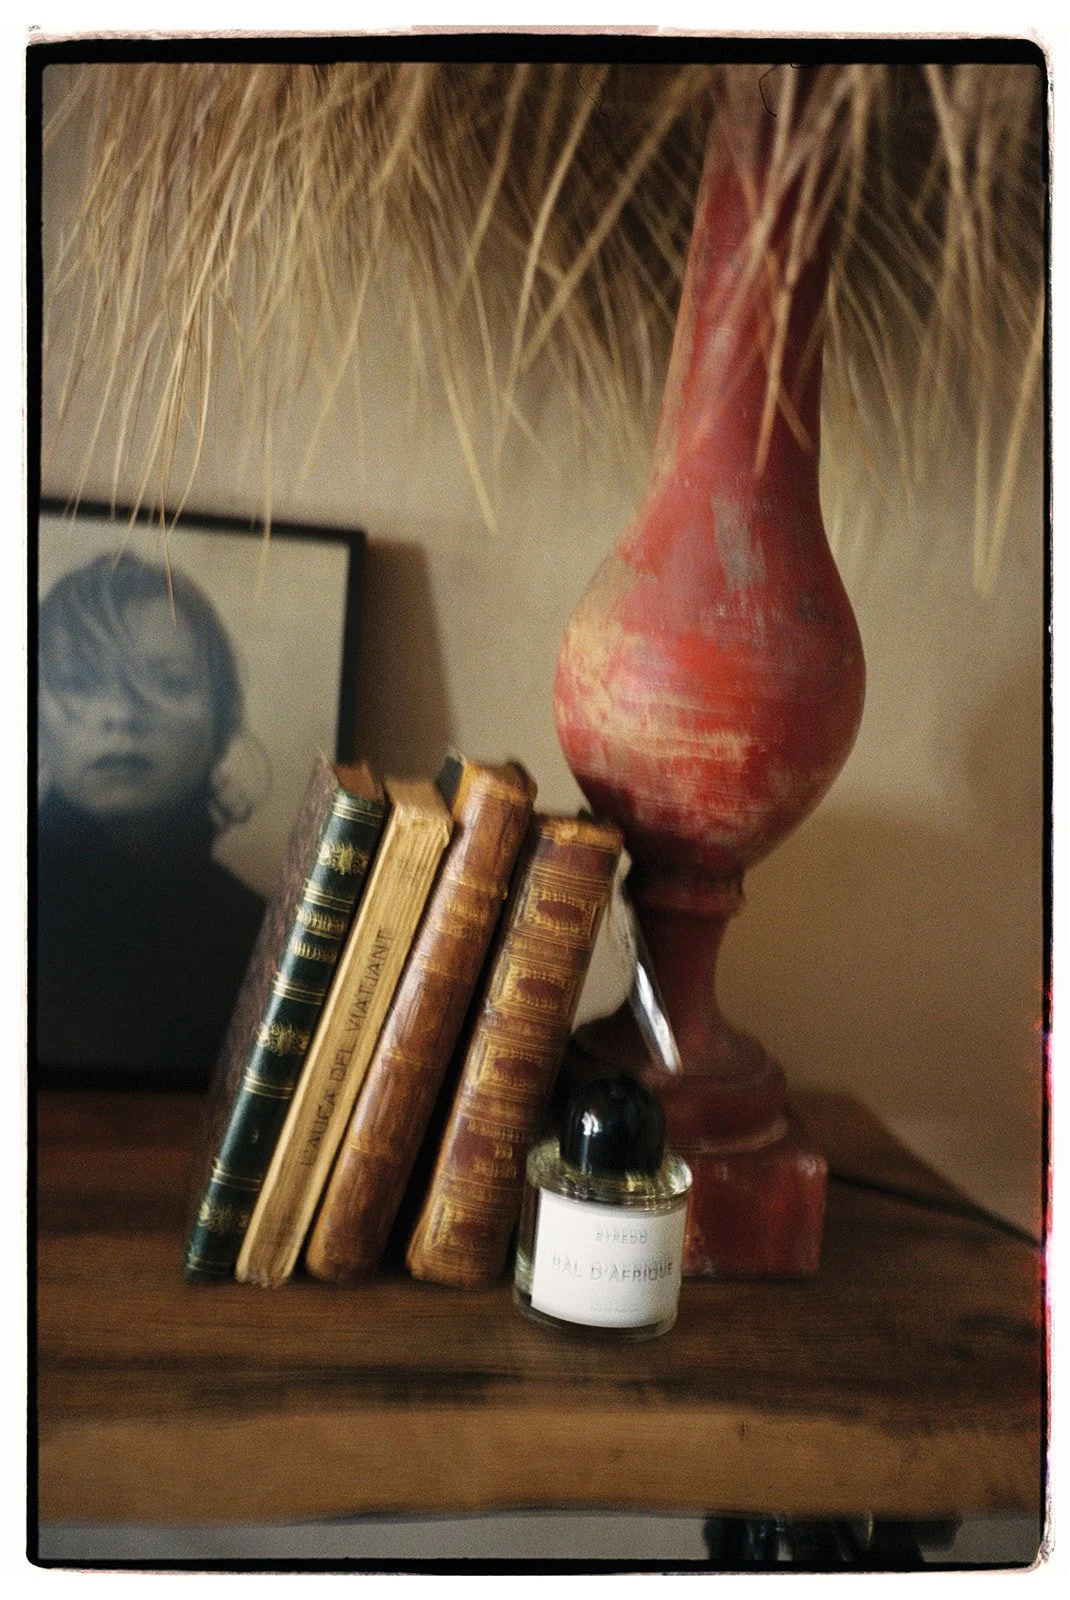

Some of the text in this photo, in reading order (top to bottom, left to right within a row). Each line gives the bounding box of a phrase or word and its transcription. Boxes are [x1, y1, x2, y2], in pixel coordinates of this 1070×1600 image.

[329, 1043, 358, 1082] DEL
[344, 926, 395, 1032] VIATJANT
[552, 1254, 674, 1283] BAL D'AFRIQUE
